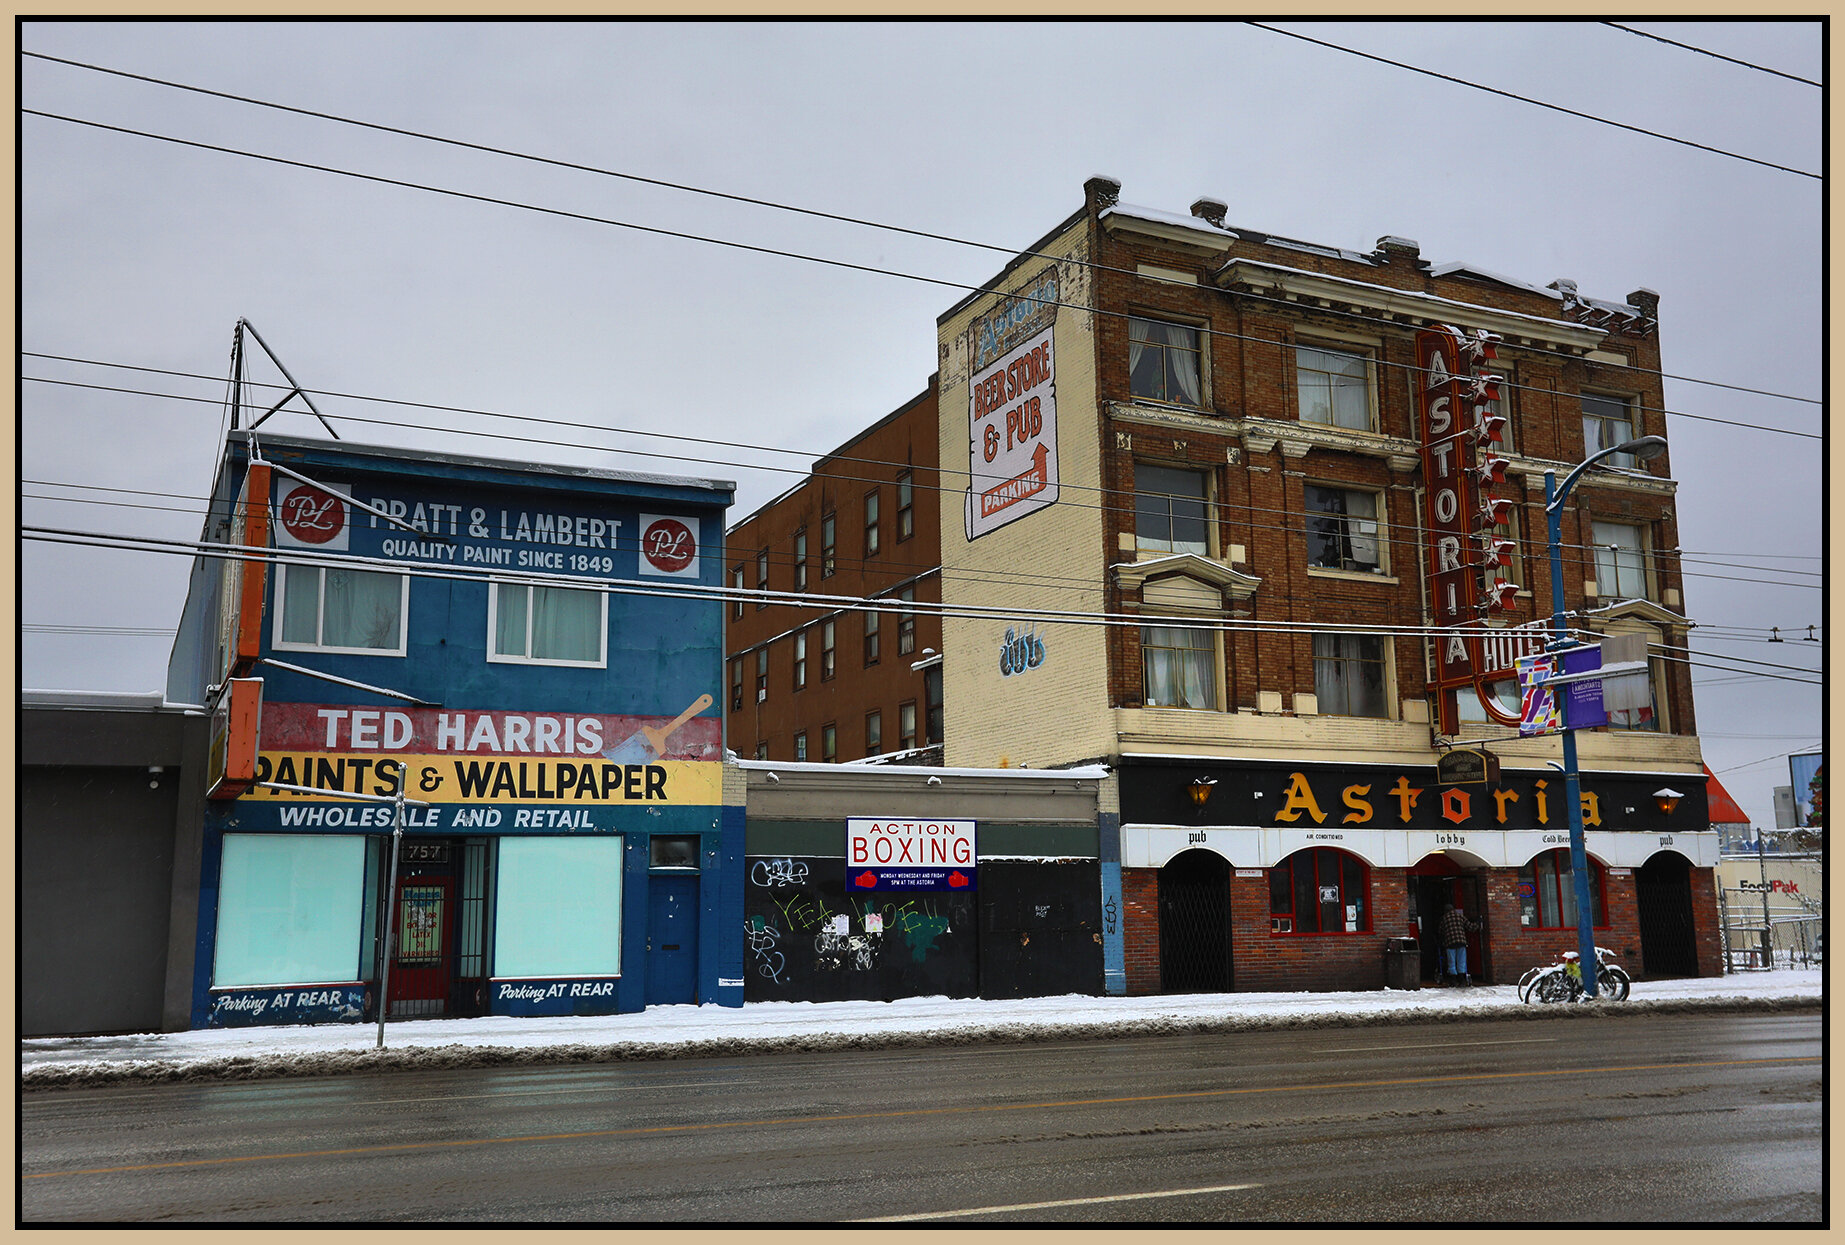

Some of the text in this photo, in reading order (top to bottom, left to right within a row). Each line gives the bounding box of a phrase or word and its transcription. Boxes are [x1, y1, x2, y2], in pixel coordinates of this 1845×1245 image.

[974, 340, 1051, 422] BEER STORE
[983, 395, 1043, 463] & PUB
[983, 470, 1041, 513] PARKING
[1427, 349, 1469, 665] ASTORIA
[370, 498, 622, 550] PRATT & LAMBERT
[382, 538, 613, 573] QUALITY PAINT SINCE 1849
[317, 708, 604, 755] TED HARRIS
[245, 756, 668, 800] PAINTS & WALLPAPER
[1274, 772, 1602, 827] Astoria
[280, 807, 594, 828] WHOLESALE AND RETAIL
[869, 823, 955, 835] ACTION
[407, 844, 441, 859] 757
[853, 837, 971, 864] BOXING
[1188, 831, 1207, 845] pub
[1436, 833, 1465, 845] lobby
[1659, 835, 1673, 847] pub
[1740, 880, 1799, 894] FoodPak
[215, 990, 342, 1015] Parking AT REAR
[498, 983, 614, 1004] Parking AT REAR
